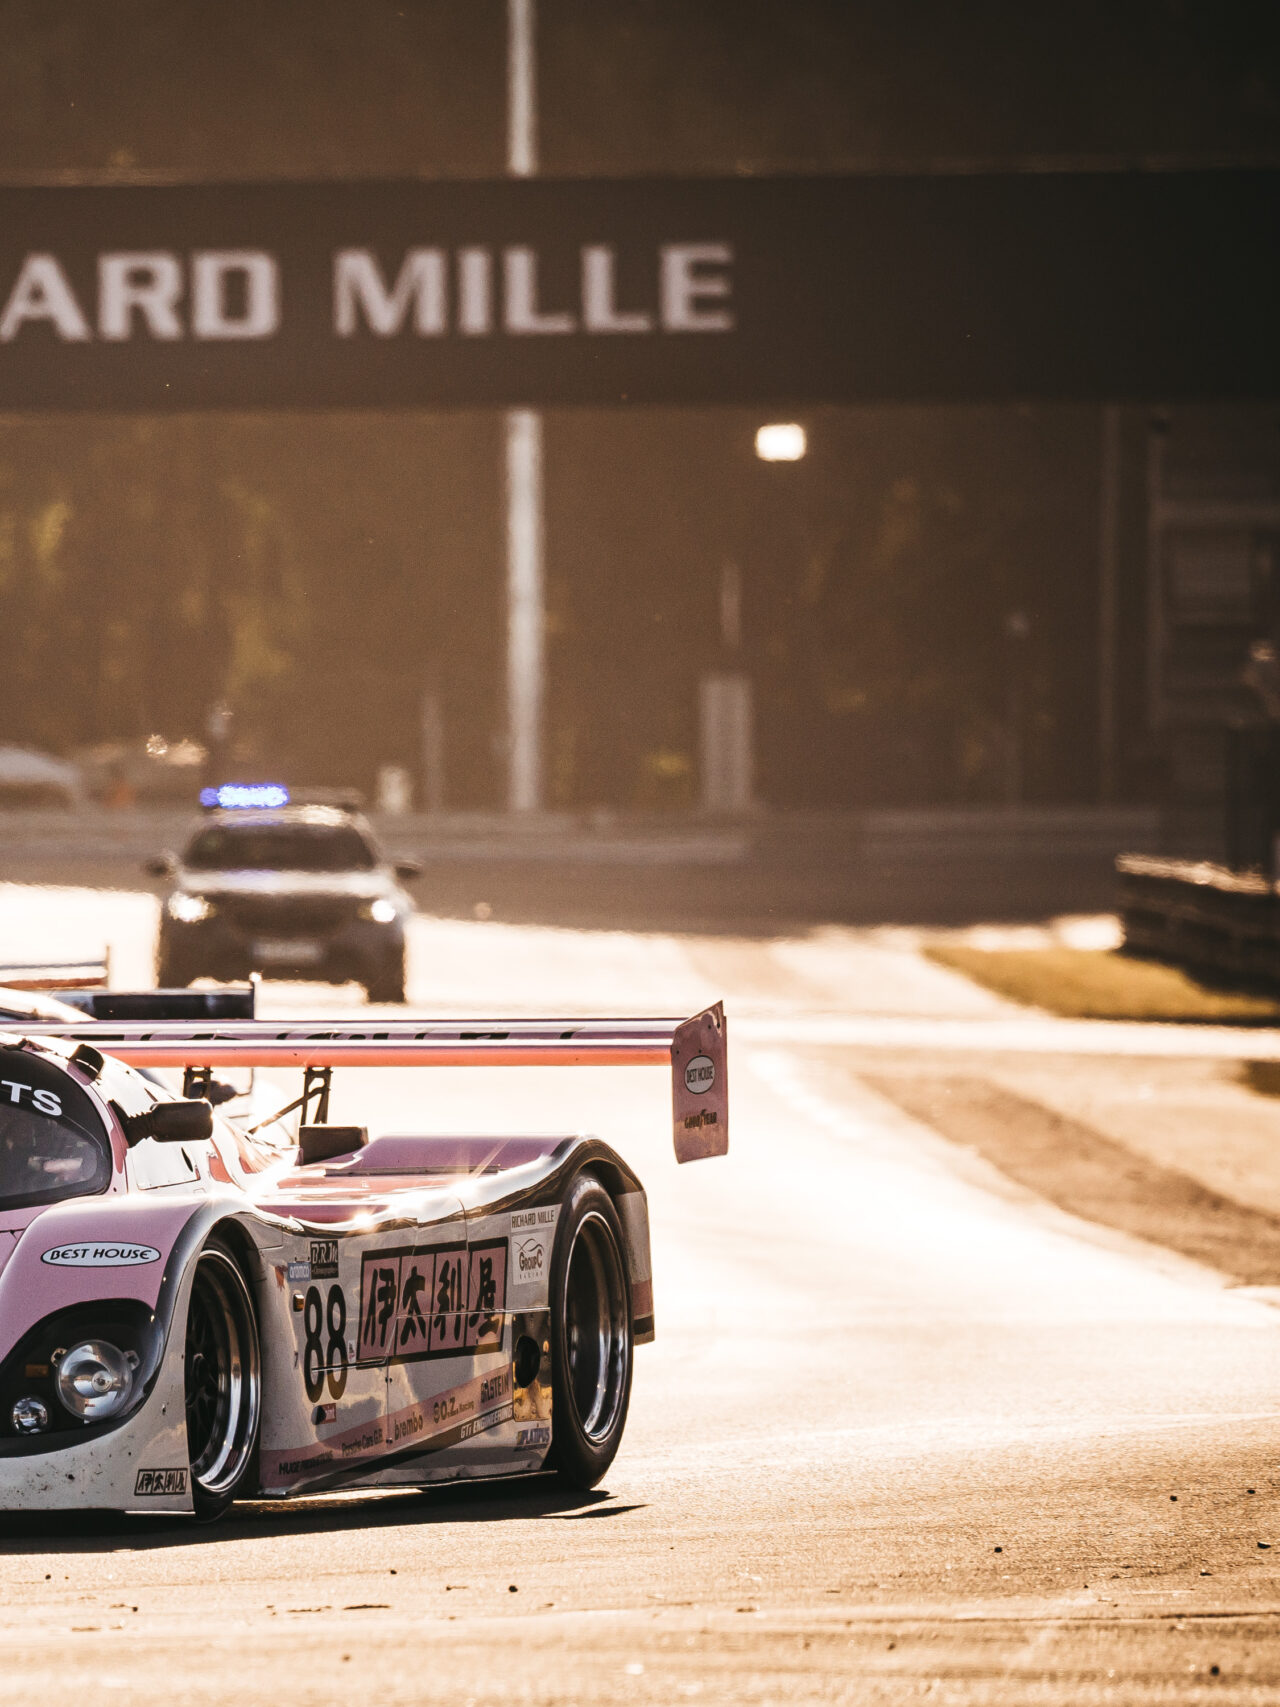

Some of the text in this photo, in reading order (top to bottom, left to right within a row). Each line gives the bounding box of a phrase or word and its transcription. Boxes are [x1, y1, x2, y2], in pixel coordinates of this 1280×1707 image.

[332, 244, 734, 338] MILLE
[686, 1066, 714, 1084] BEST HOUSE
[511, 1210, 555, 1229] RICHARD MILLE
[50, 1249, 152, 1260] BEST HOUSE
[304, 1284, 348, 1404] 88
[394, 1411, 424, 1441] brembo
